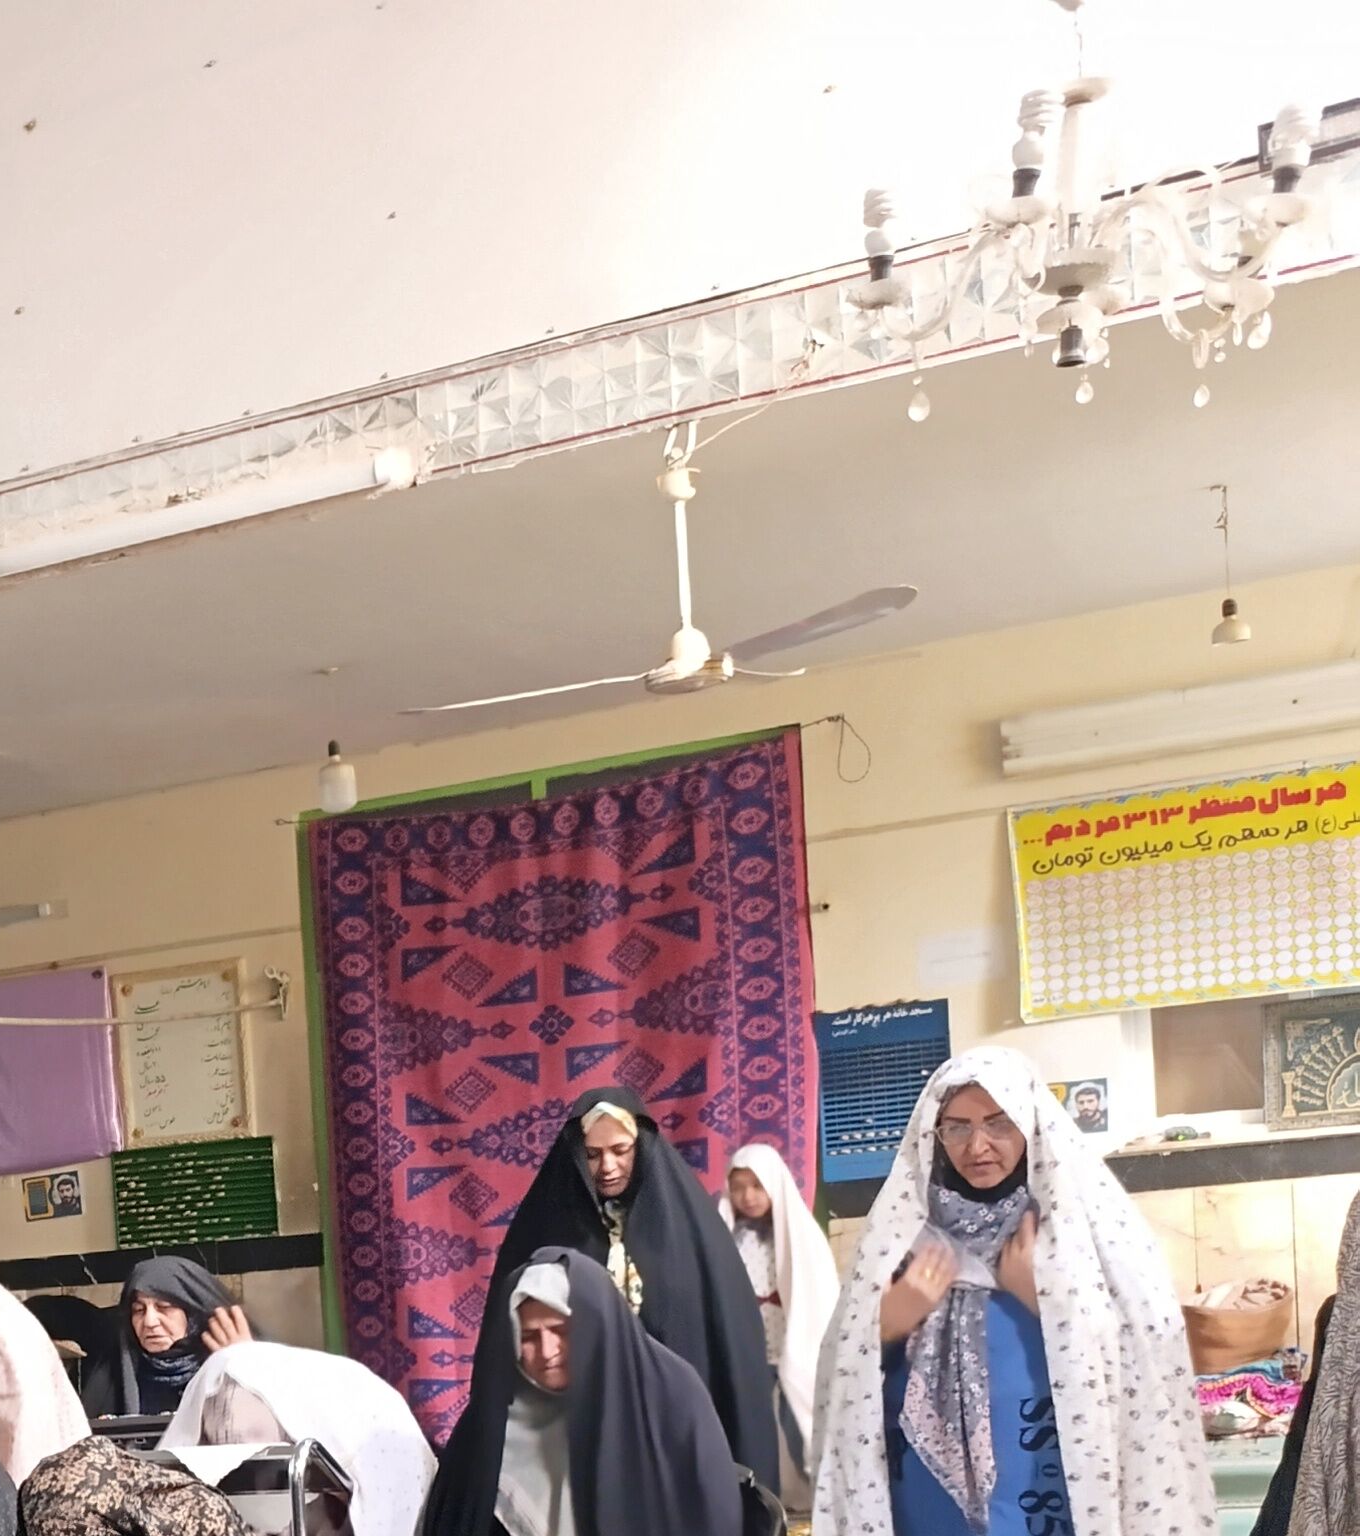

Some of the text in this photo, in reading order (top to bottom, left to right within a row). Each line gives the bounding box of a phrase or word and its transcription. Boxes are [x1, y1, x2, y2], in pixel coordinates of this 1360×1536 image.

[1258, 786, 1311, 815] سال
[1315, 780, 1347, 806] هر
[1123, 805, 1184, 830] ۳۱۳
[1188, 794, 1256, 825] منتظر
[1179, 830, 1212, 851] یک
[1218, 826, 1280, 849] سهم
[1284, 819, 1308, 840] هر
[1032, 846, 1094, 875] تومان
[1099, 839, 1173, 866] میلیون
